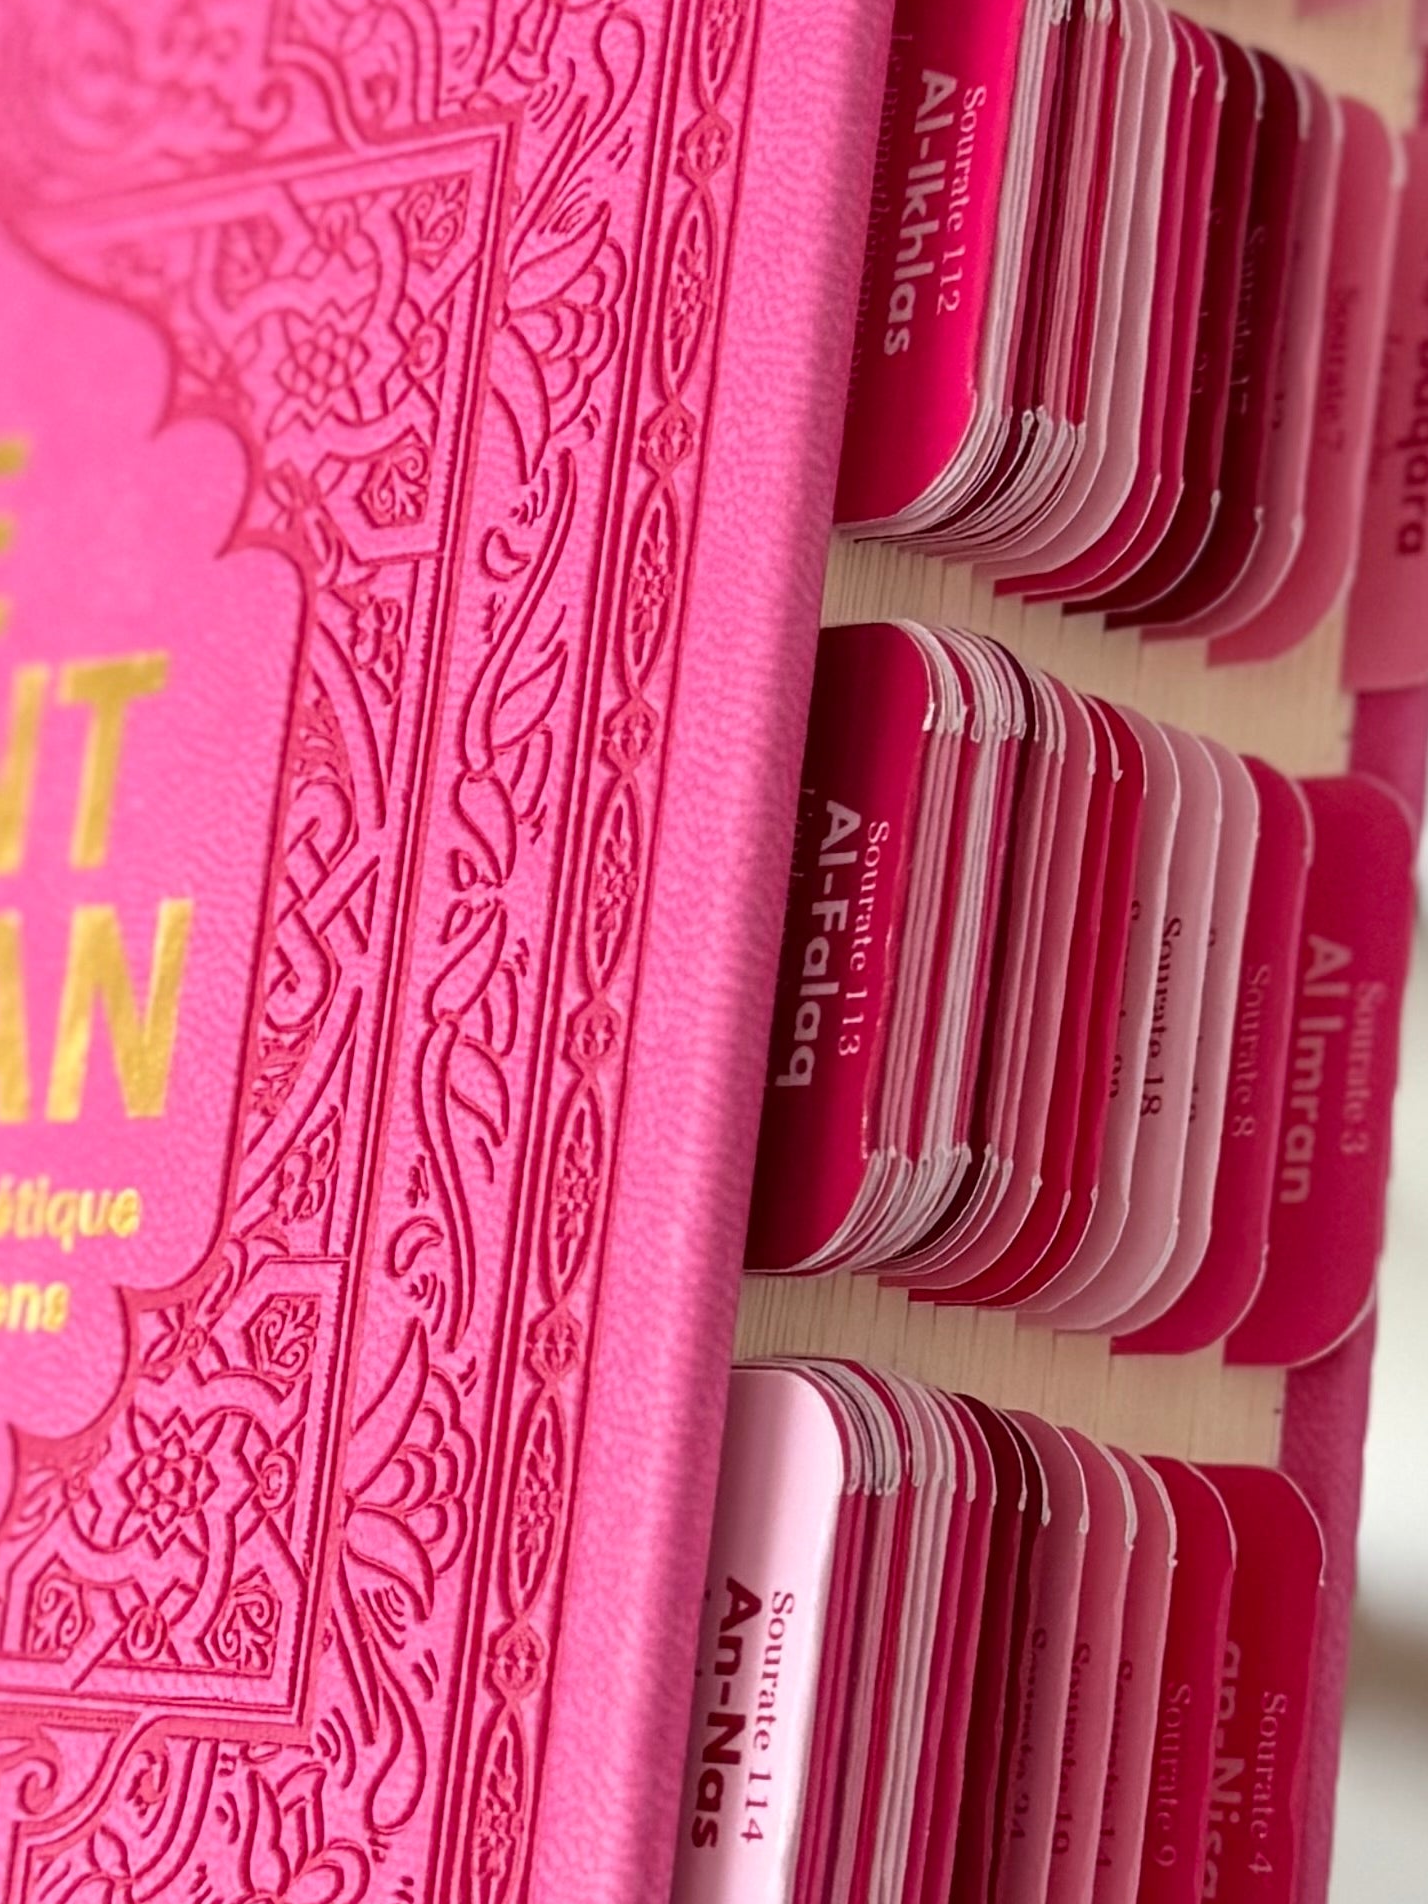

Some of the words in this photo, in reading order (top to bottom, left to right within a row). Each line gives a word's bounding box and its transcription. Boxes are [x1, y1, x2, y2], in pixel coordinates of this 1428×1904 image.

[883, 67, 960, 358] Al-Ikhlas
[946, 84, 988, 233] Sourate
[936, 244, 967, 316] 112
[775, 798, 862, 1087] Al-Falaq
[849, 819, 890, 972] Sourate
[1302, 934, 1354, 997] Al
[838, 989, 869, 1057] 113
[1234, 963, 1272, 1105] Sourate
[1231, 1115, 1256, 1138] 8
[1279, 1015, 1346, 1205] Imran
[691, 1576, 763, 1849] An-Nas
[753, 1590, 794, 1752] Sourate
[740, 1770, 773, 1844] 114
[1156, 1683, 1191, 1831] Sourate
[1250, 1690, 1288, 1840] Sourate
[1154, 1843, 1178, 1868] 9
[1247, 1851, 1273, 1875] 4
